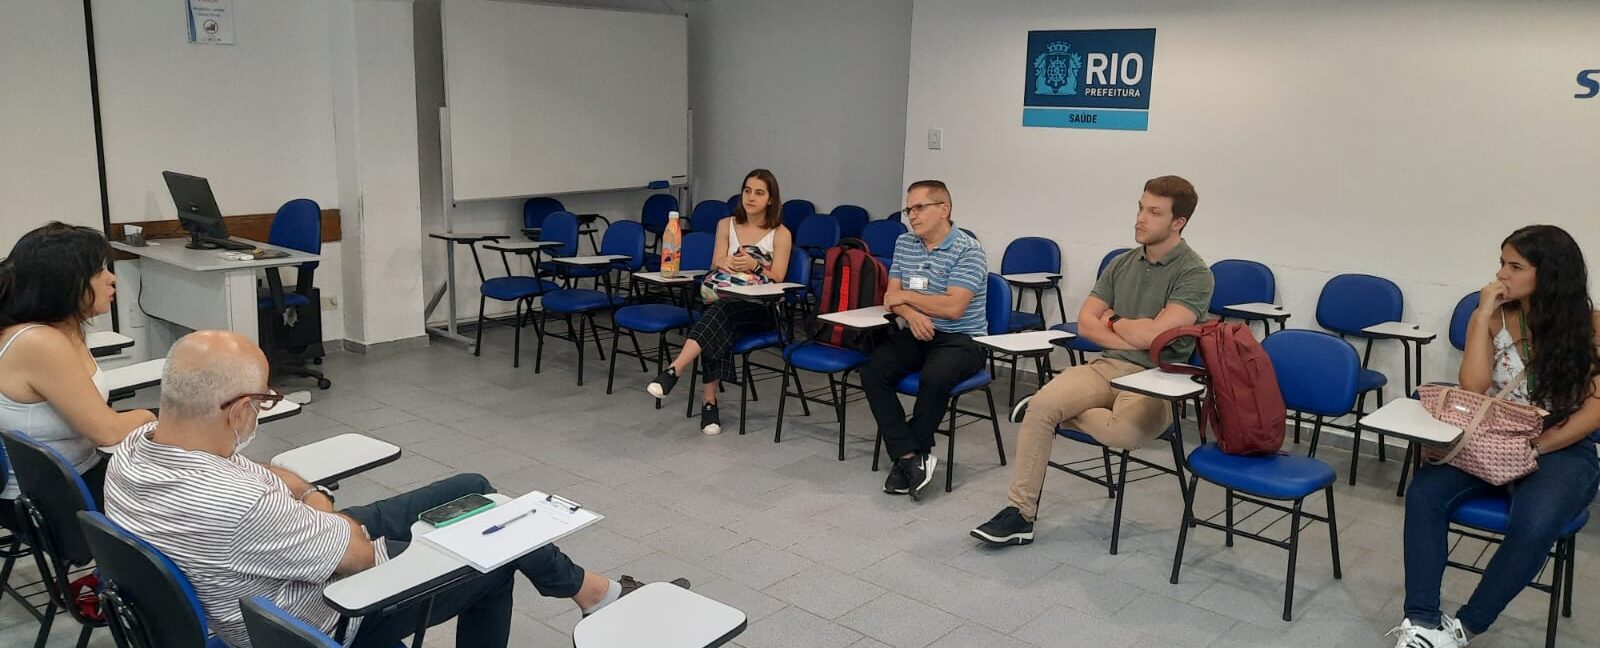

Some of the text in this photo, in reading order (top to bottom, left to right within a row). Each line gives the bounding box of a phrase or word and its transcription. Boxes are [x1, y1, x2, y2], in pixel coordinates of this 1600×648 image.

[1086, 53, 1144, 86] RIO
[1085, 88, 1141, 97] PREFEITURA
[1069, 113, 1098, 124] SAÚDE
